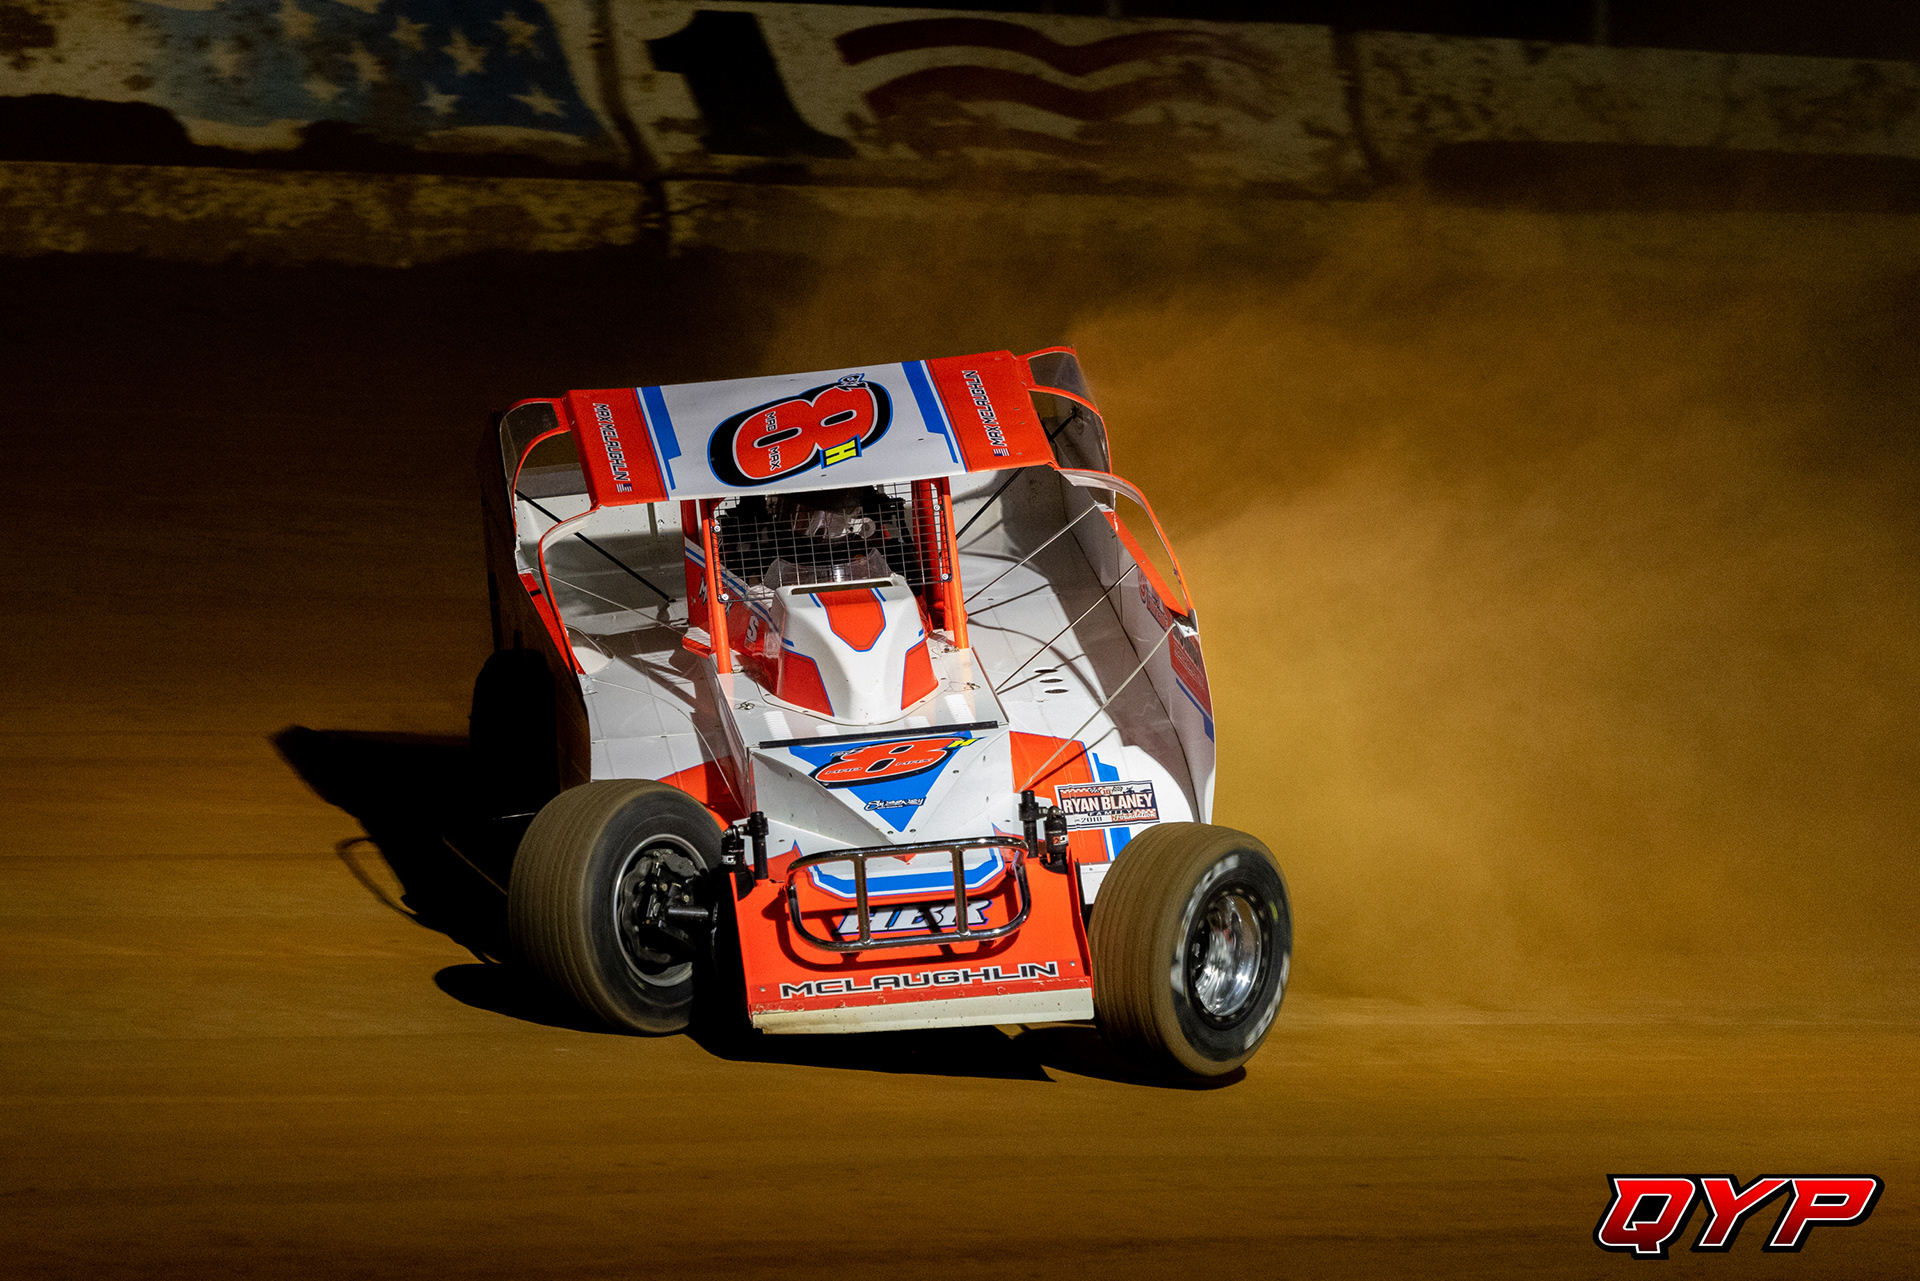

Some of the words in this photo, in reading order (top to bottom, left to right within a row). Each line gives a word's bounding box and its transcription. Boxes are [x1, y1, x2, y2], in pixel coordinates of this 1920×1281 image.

[592, 402, 614, 423] MAX
[983, 425, 1007, 447] MAX
[768, 446, 782, 471] MAX
[1062, 796, 1100, 814] RYAN
[1101, 793, 1153, 811] BLANEY
[780, 961, 1059, 999] MCLAUGHLIN
